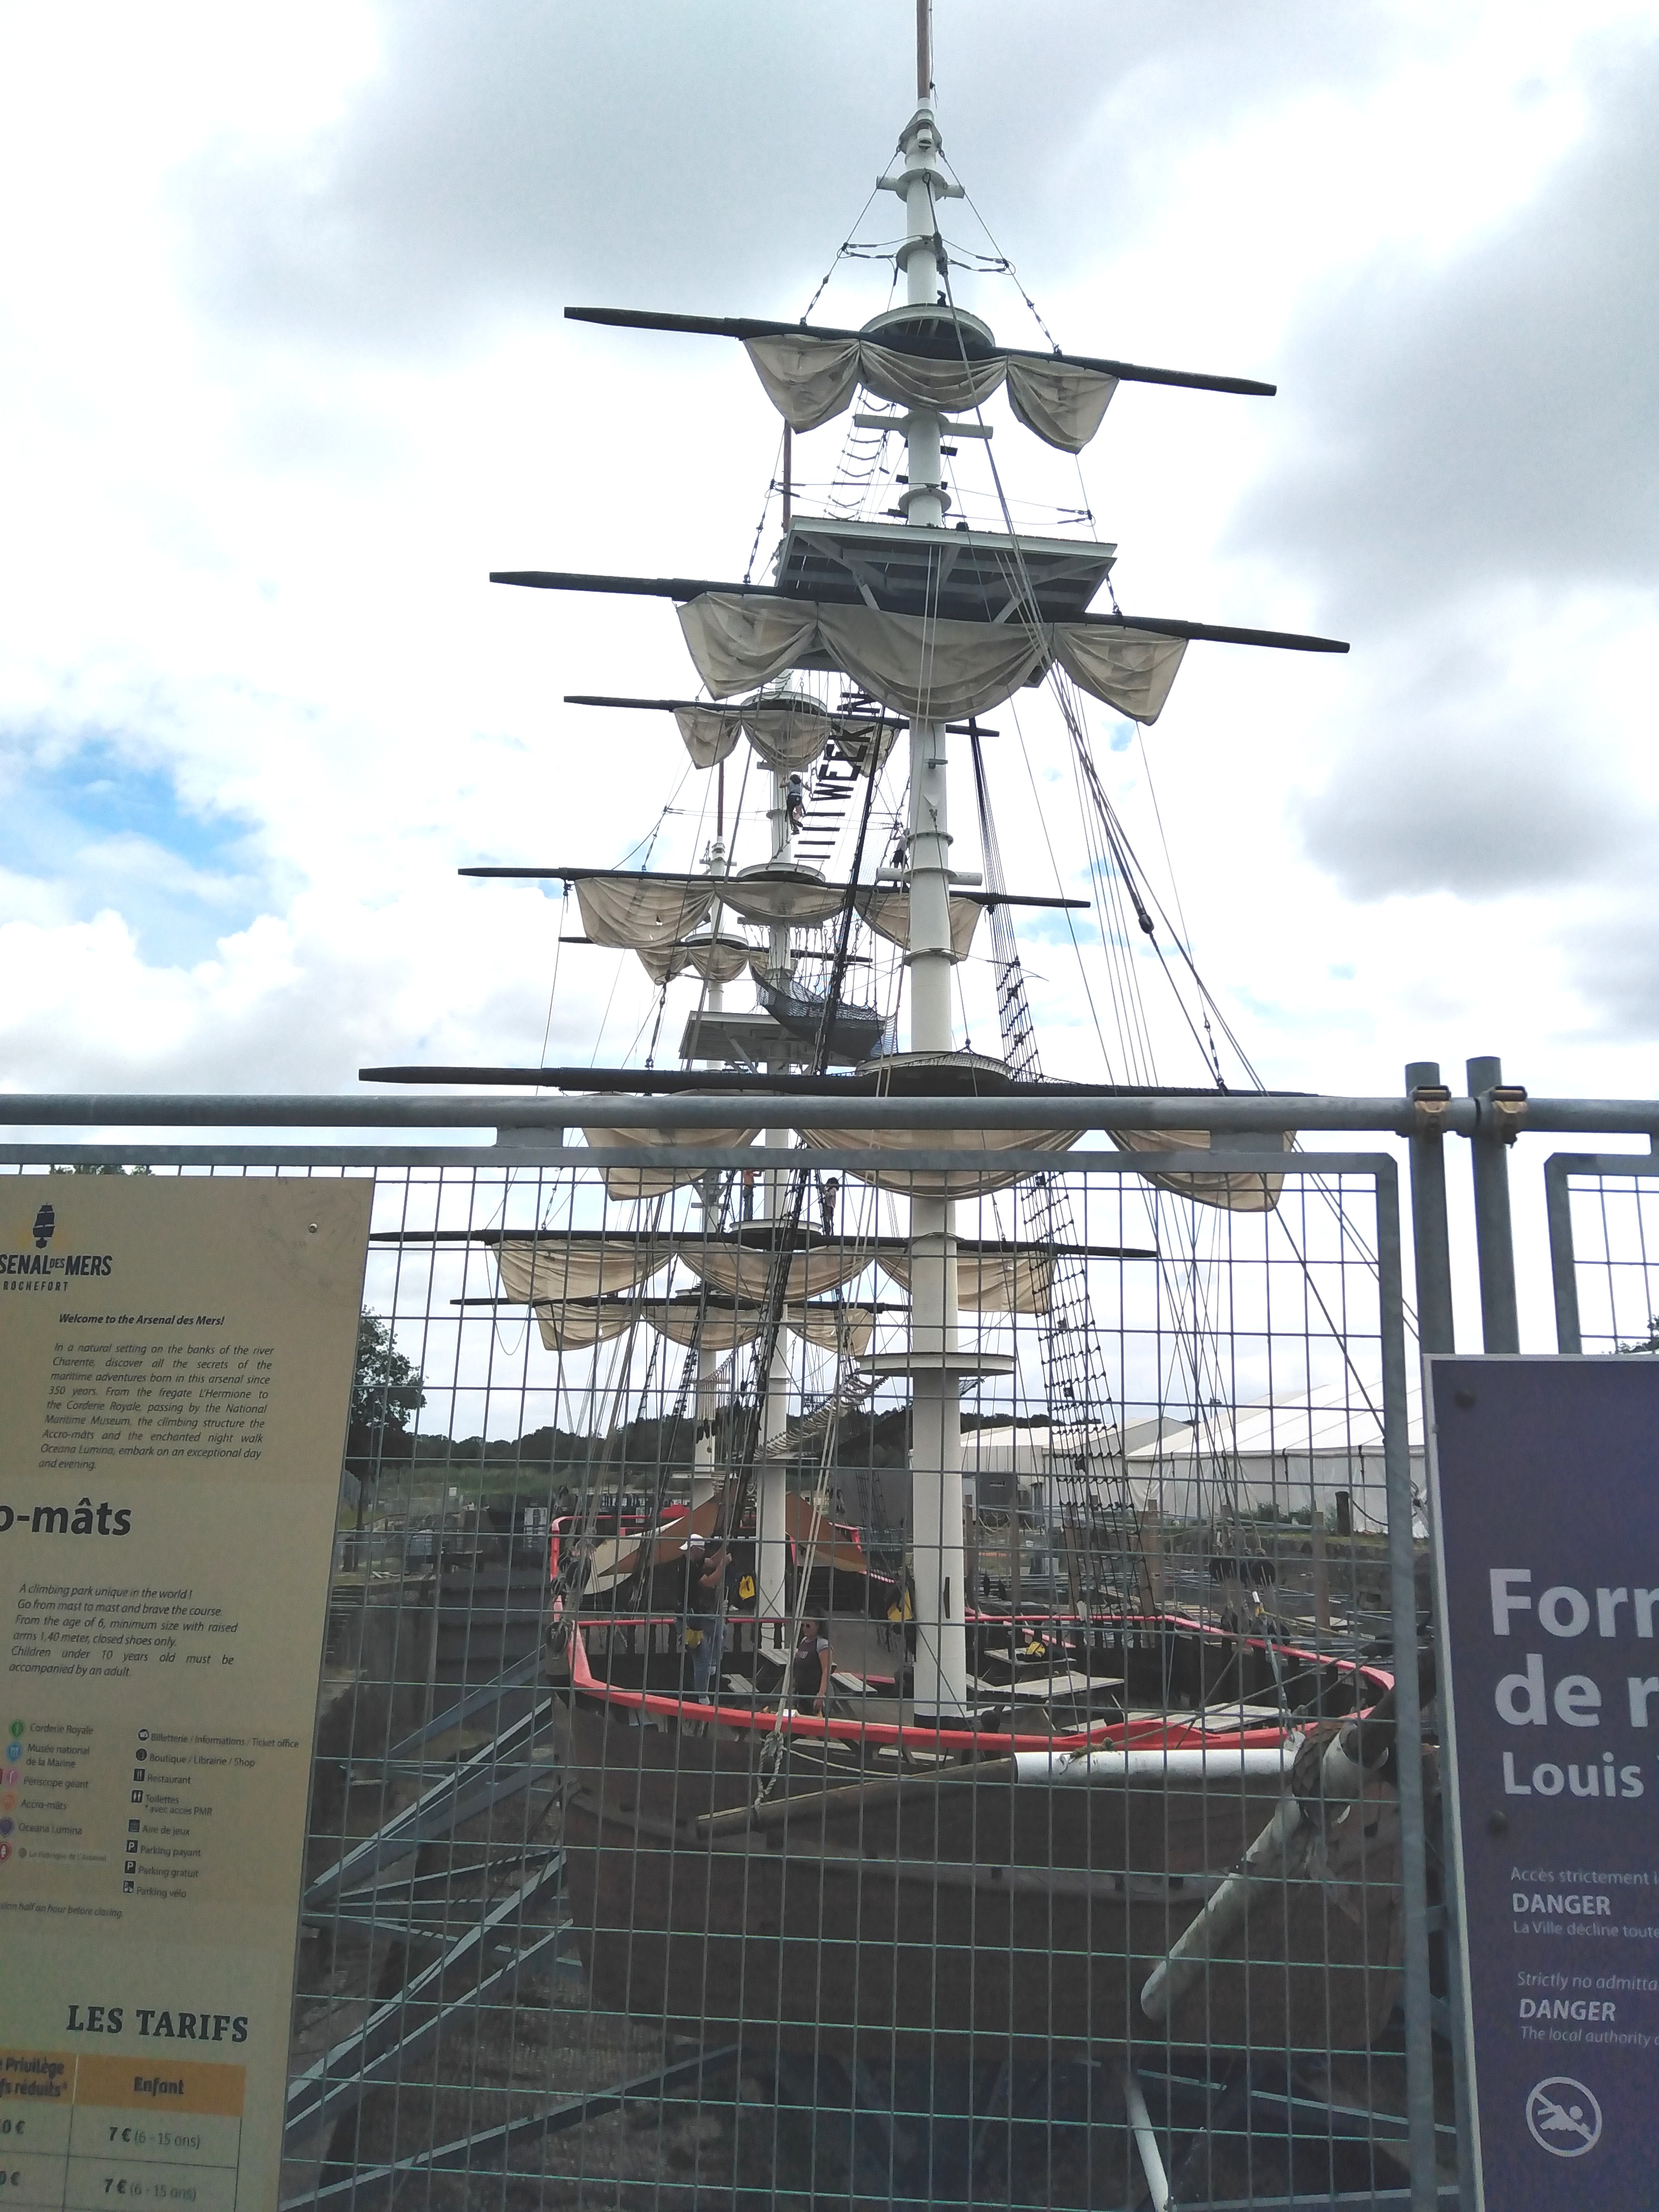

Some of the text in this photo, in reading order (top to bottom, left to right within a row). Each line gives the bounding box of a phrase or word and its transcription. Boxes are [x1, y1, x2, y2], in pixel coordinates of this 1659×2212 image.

[65, 1255, 113, 1276] MERS
[3, 1280, 68, 1291] ROCHEFORT
[59, 1313, 225, 1326] Welcome to the Arsenal des Mers!
[55, 1343, 63, 1352] In
[78, 1344, 112, 1352] natural
[115, 1345, 147, 1355] setting
[187, 1345, 215, 1354] banks
[53, 1357, 228, 1369] Charente, discover all secrets
[51, 1372, 270, 1384] maritime adventures born this arsenal since
[72, 1387, 97, 1397] years.
[106, 1387, 129, 1396] From
[159, 1387, 192, 1399] fregate
[66, 1401, 267, 1414] Corderie Royale, passing National
[45, 1415, 245, 1429] Maritime Museum, climbing structure
[150, 1432, 201, 1442] enchanted
[208, 1434, 233, 1444] night
[241, 1434, 263, 1443] walk
[41, 1444, 262, 1460] Oceana Lumina, embark exceptional day
[58, 1461, 96, 1471] evening.
[29, 1584, 187, 1599] climbing park unique world
[18, 1599, 222, 1616] Go from mast mast brave course.
[15, 1615, 238, 1632] From age 6, minimum size with raised
[41, 1632, 60, 1642] 1,40
[61, 1634, 90, 1644] meter,
[93, 1633, 124, 1644] closed
[125, 1635, 152, 1646] shoes
[154, 1636, 177, 1648] only.
[12, 1646, 234, 1665] Children under 10 years old must be
[9, 1664, 131, 1677] accompanied adult.
[1495, 1653, 1602, 1728] de
[1503, 1752, 1645, 1797] Louis
[1511, 1866, 1650, 1886] Accès strictement
[1512, 1892, 1612, 1916] DANGER
[1513, 1920, 1530, 1934] La
[1532, 1921, 1563, 1935] Ville
[1567, 1922, 1620, 1937] décline
[1518, 1971, 1569, 1991] Strictly
[1572, 1976, 1592, 1989] no
[1519, 1997, 1616, 2022] DANGER
[66, 2005, 248, 2042] LES TARIFS
[1521, 2025, 1545, 2040] The
[1549, 2027, 1582, 2042] local
[1585, 2029, 1651, 2049] authority
[135, 2076, 185, 2097] Enfant
